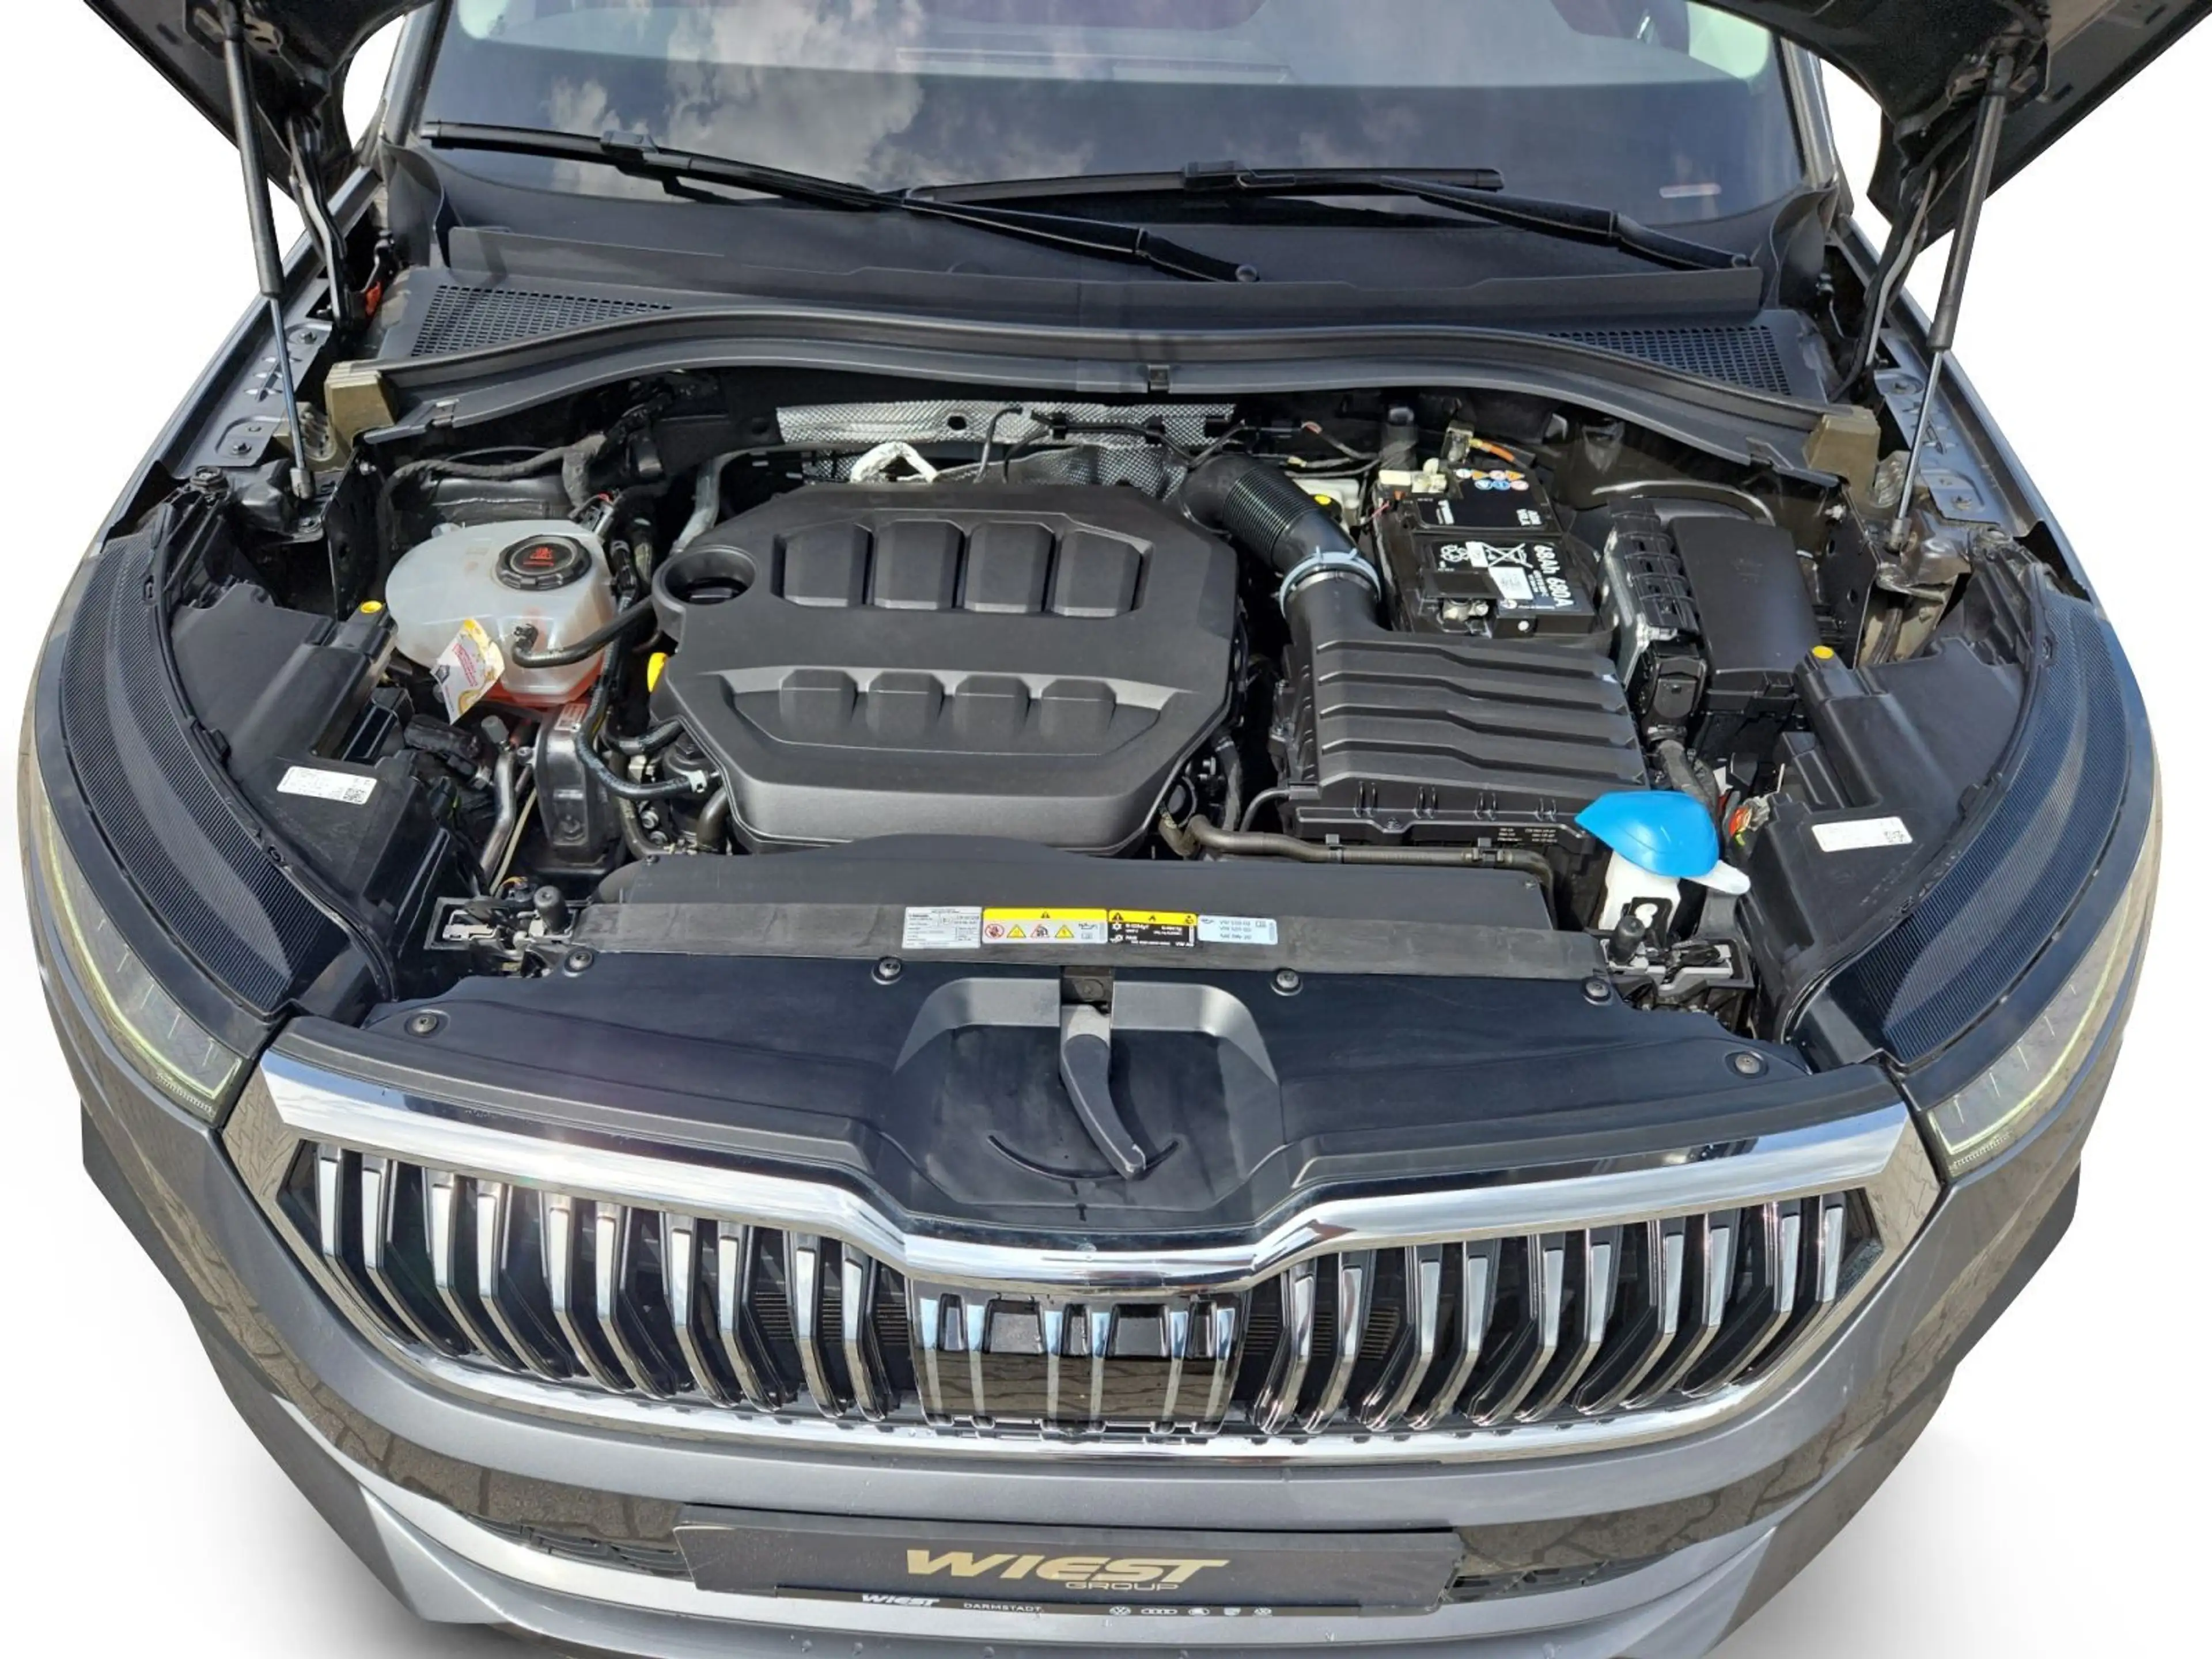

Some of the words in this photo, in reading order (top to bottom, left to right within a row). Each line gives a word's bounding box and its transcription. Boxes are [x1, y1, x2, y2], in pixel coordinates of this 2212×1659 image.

[1534, 544, 1560, 574] 68Ah
[1546, 577, 1574, 607] 680A
[907, 1549, 1230, 1583] WIEST
[1065, 1582, 1179, 1591] GROUP
[862, 1594, 940, 1607] WIEST
[964, 1602, 1041, 1612] DARMSTADT
